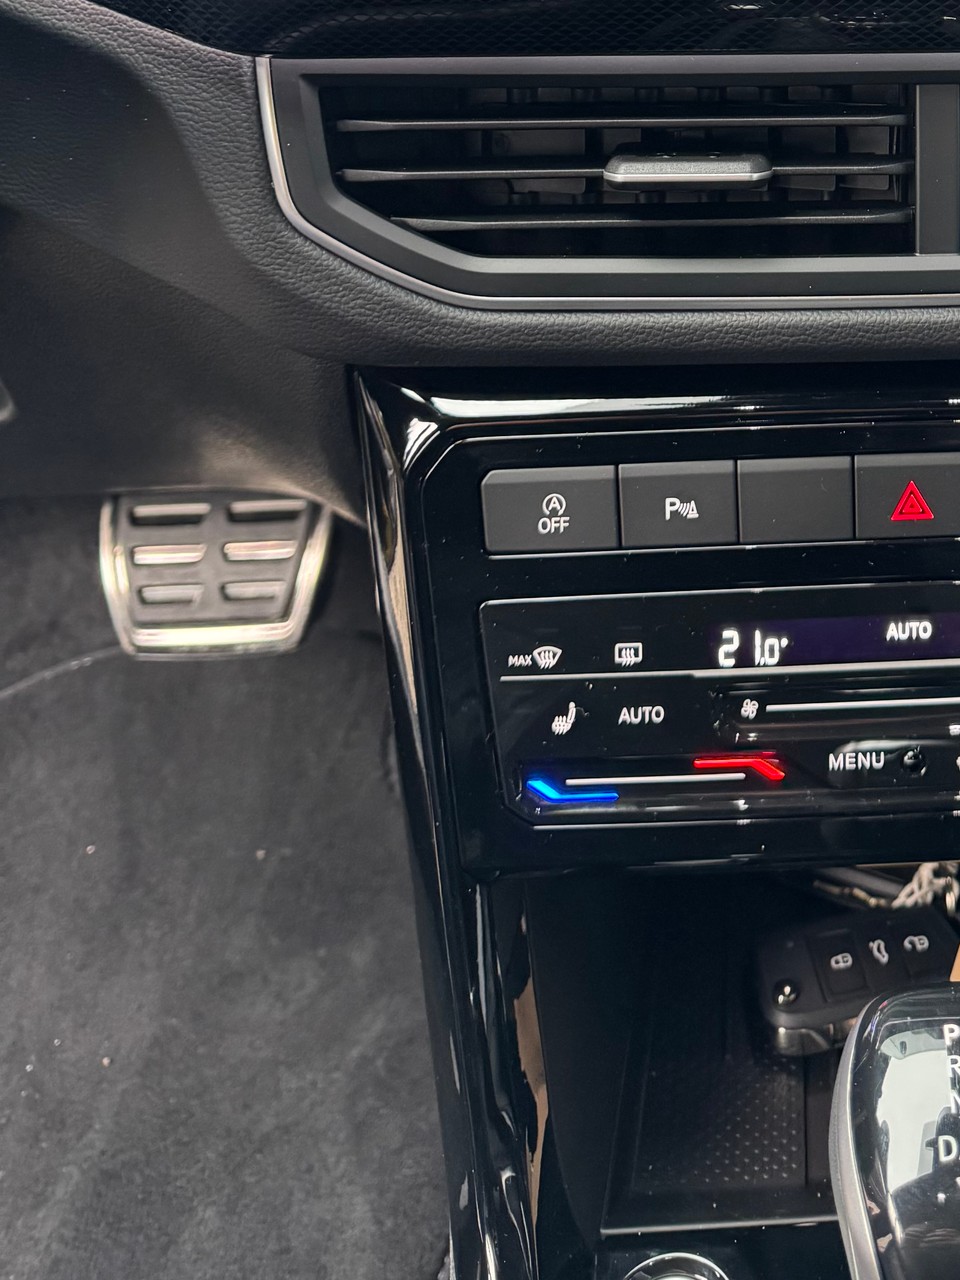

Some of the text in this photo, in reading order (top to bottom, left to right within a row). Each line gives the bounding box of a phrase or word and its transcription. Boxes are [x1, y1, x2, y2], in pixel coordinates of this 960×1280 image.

[537, 516, 571, 535] OFF
[885, 620, 933, 642] AUTO
[507, 653, 533, 668] MAX
[617, 705, 666, 726] AUTO
[828, 751, 886, 772] MENU
